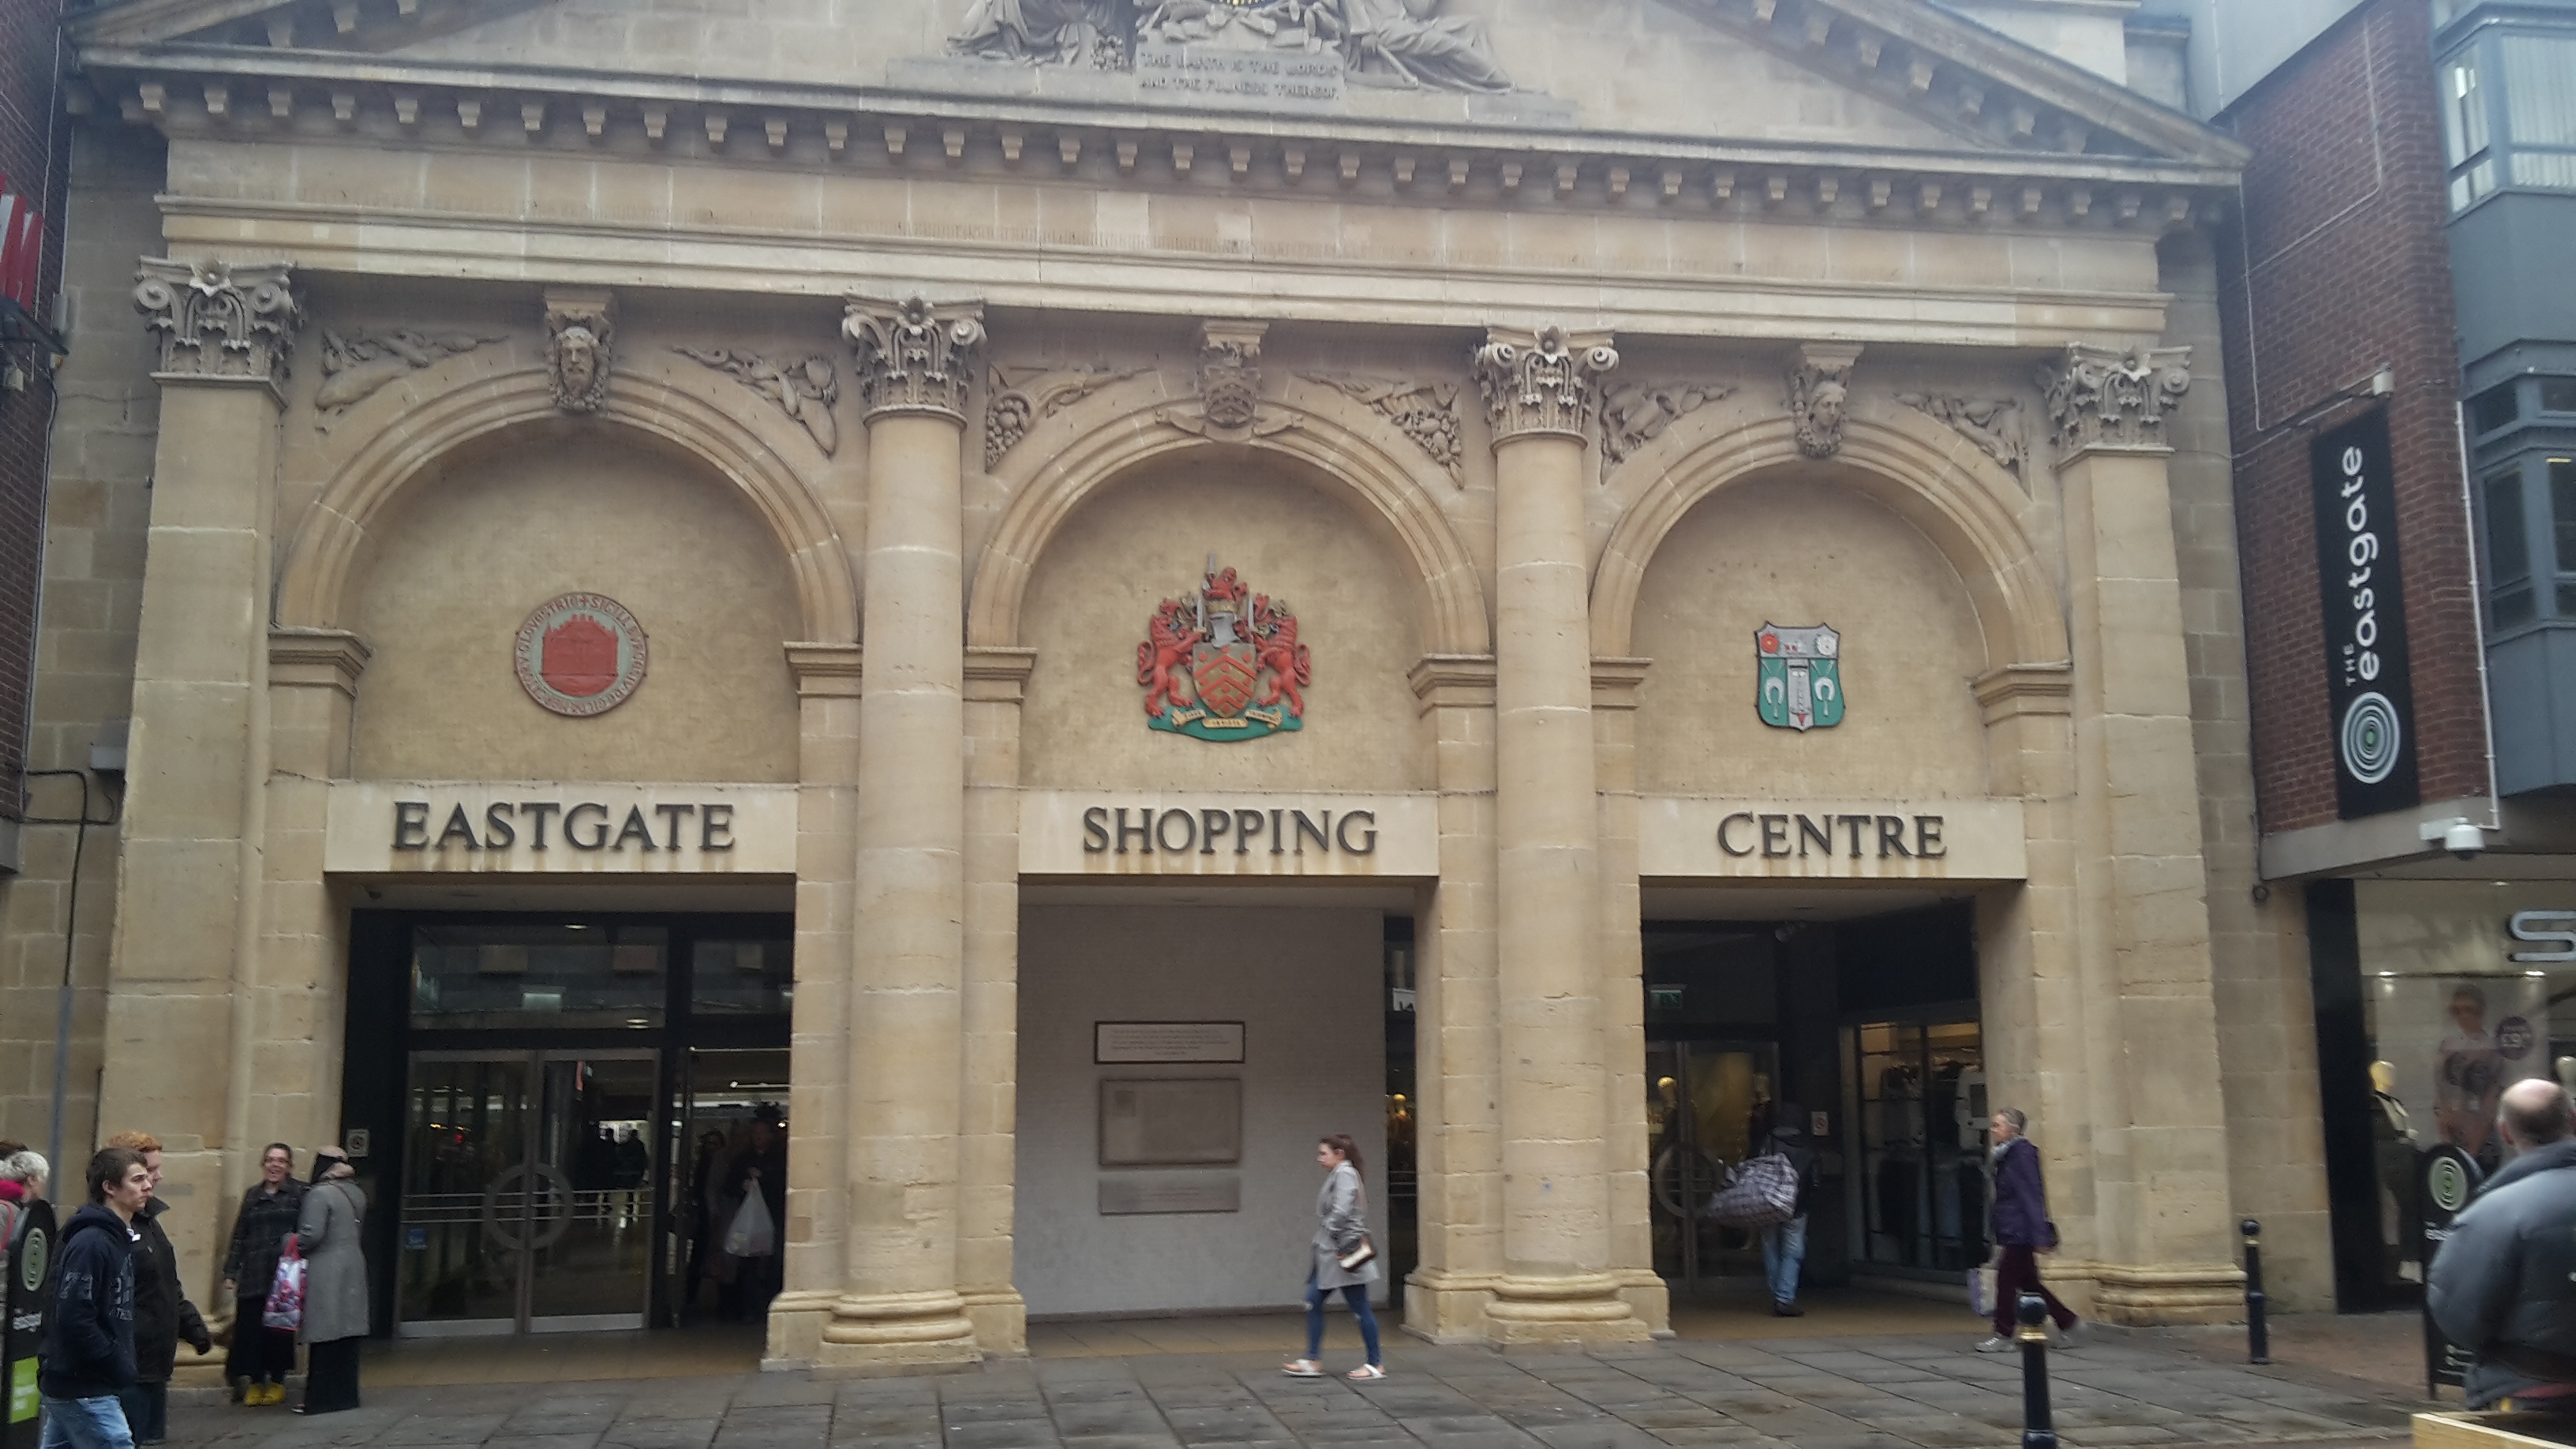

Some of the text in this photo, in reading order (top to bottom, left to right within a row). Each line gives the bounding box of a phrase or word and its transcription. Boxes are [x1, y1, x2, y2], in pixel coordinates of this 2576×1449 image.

[2341, 445, 2380, 681] eastgate
[2342, 642, 2357, 687] THE
[391, 801, 736, 852] EASTGATE
[1083, 806, 1380, 856] SHOPPING
[1717, 811, 1948, 859] CENTRE
